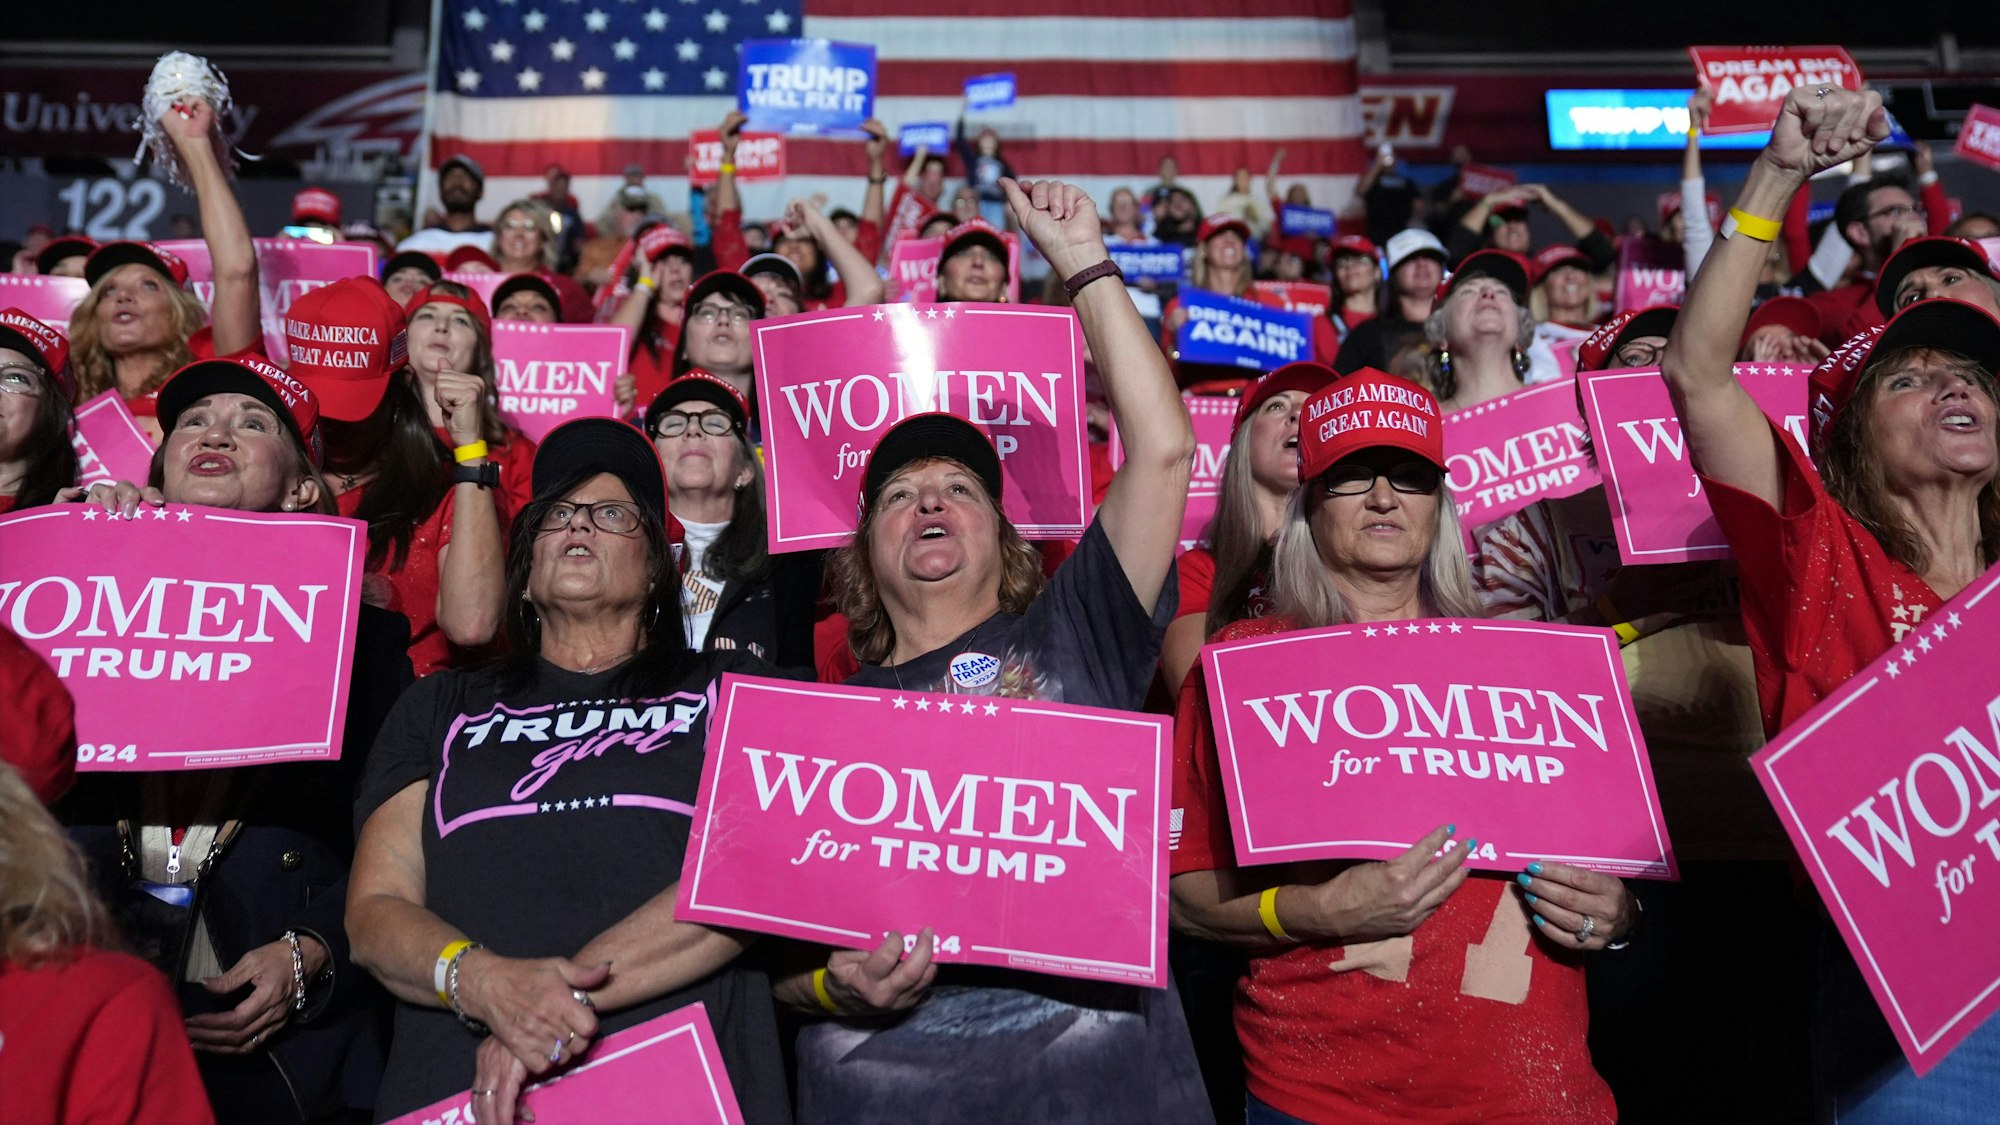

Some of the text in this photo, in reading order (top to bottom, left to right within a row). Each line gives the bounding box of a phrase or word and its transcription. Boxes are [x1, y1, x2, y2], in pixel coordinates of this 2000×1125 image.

[746, 62, 868, 94] TRUMP
[1707, 58, 1796, 77] DREAM
[746, 88, 801, 110] WILL
[694, 138, 780, 161] TRMP
[58, 177, 167, 241] 122
[310, 324, 379, 346] AMERICA
[1187, 304, 1307, 348] DREAM BIG,
[1189, 319, 1299, 362] AGAIN!
[321, 349, 371, 369] AGAIN
[494, 358, 612, 396] MEN
[248, 359, 309, 403] MERICA
[499, 395, 578, 415] RUMP
[779, 370, 1062, 439] WOMEN
[1308, 383, 1435, 423] MAKE AMERICA
[1318, 409, 1428, 443] GREAT AGAIN
[832, 442, 872, 480] for
[1444, 421, 1592, 493] OMEN
[1475, 464, 1581, 508] TRUMP
[51, 647, 252, 681] TRUMP
[952, 655, 990, 673] TEAM
[953, 659, 999, 682] TRUMP
[973, 671, 996, 686] 2024
[462, 695, 707, 750] TRUMP
[1243, 683, 1609, 752] WOMEN
[77, 743, 138, 763] 024
[509, 718, 687, 801] girl
[1323, 747, 1565, 787] for TRUMP
[742, 747, 1137, 852] WOMEN
[1826, 695, 2000, 888] WOM
[791, 829, 1067, 884] for TRUMP
[1434, 838, 1498, 862] 24
[1936, 853, 1977, 924] for
